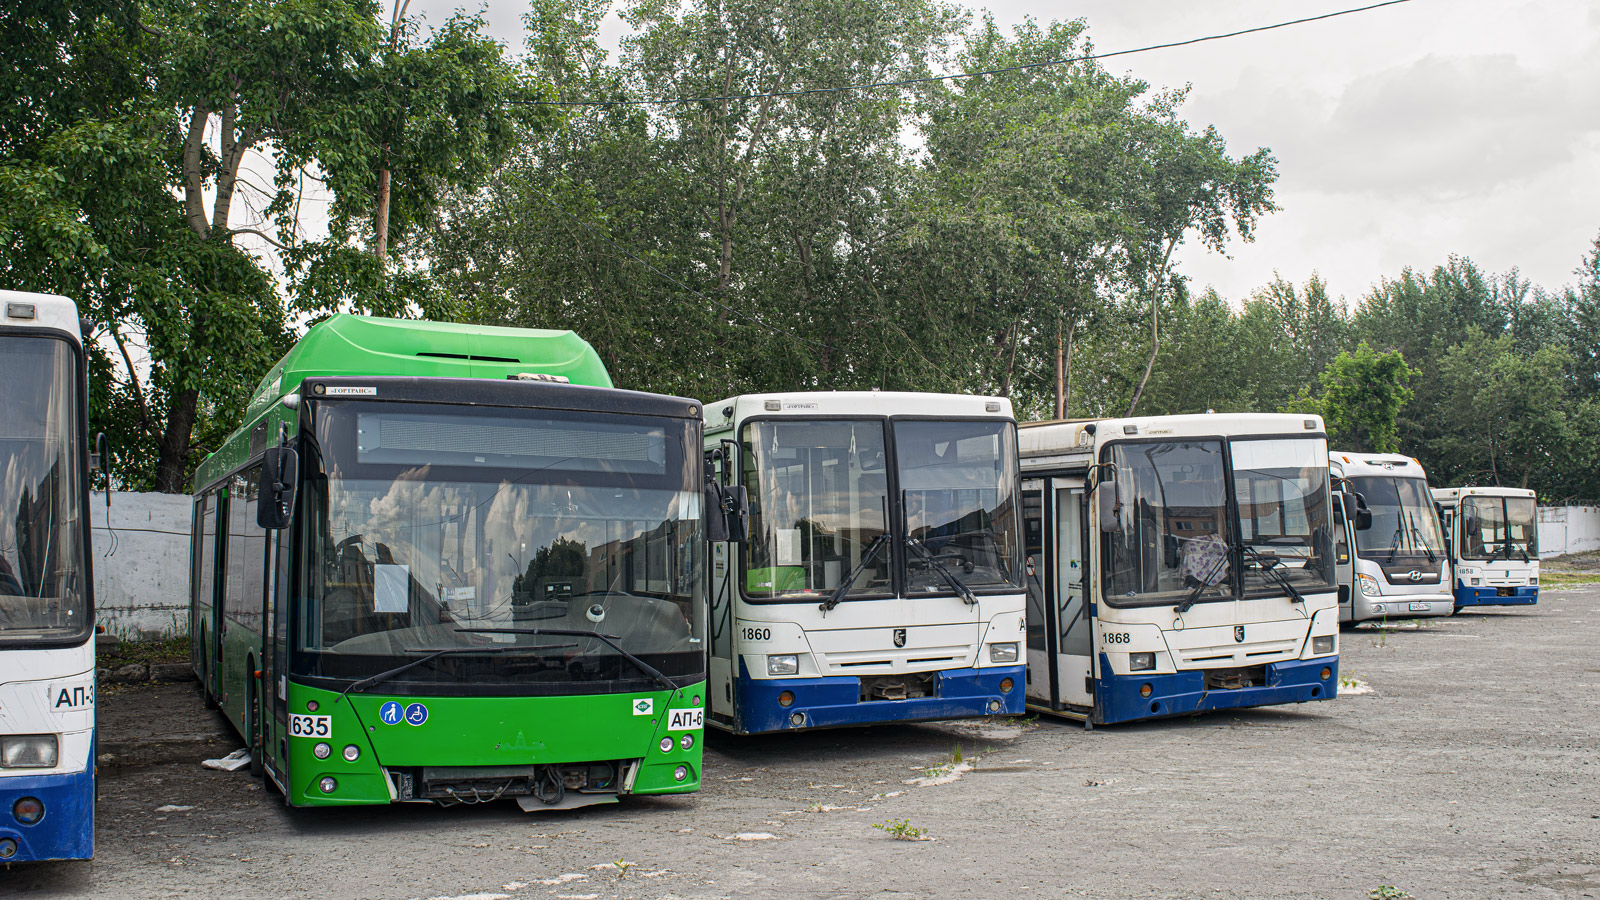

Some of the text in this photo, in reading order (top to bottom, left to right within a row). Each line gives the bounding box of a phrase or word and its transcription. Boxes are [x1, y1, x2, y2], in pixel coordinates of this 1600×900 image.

[742, 627, 771, 641] 1860
[1103, 632, 1131, 644] 1868
[55, 684, 94, 708] АП-3
[671, 711, 703, 727] АП-6
